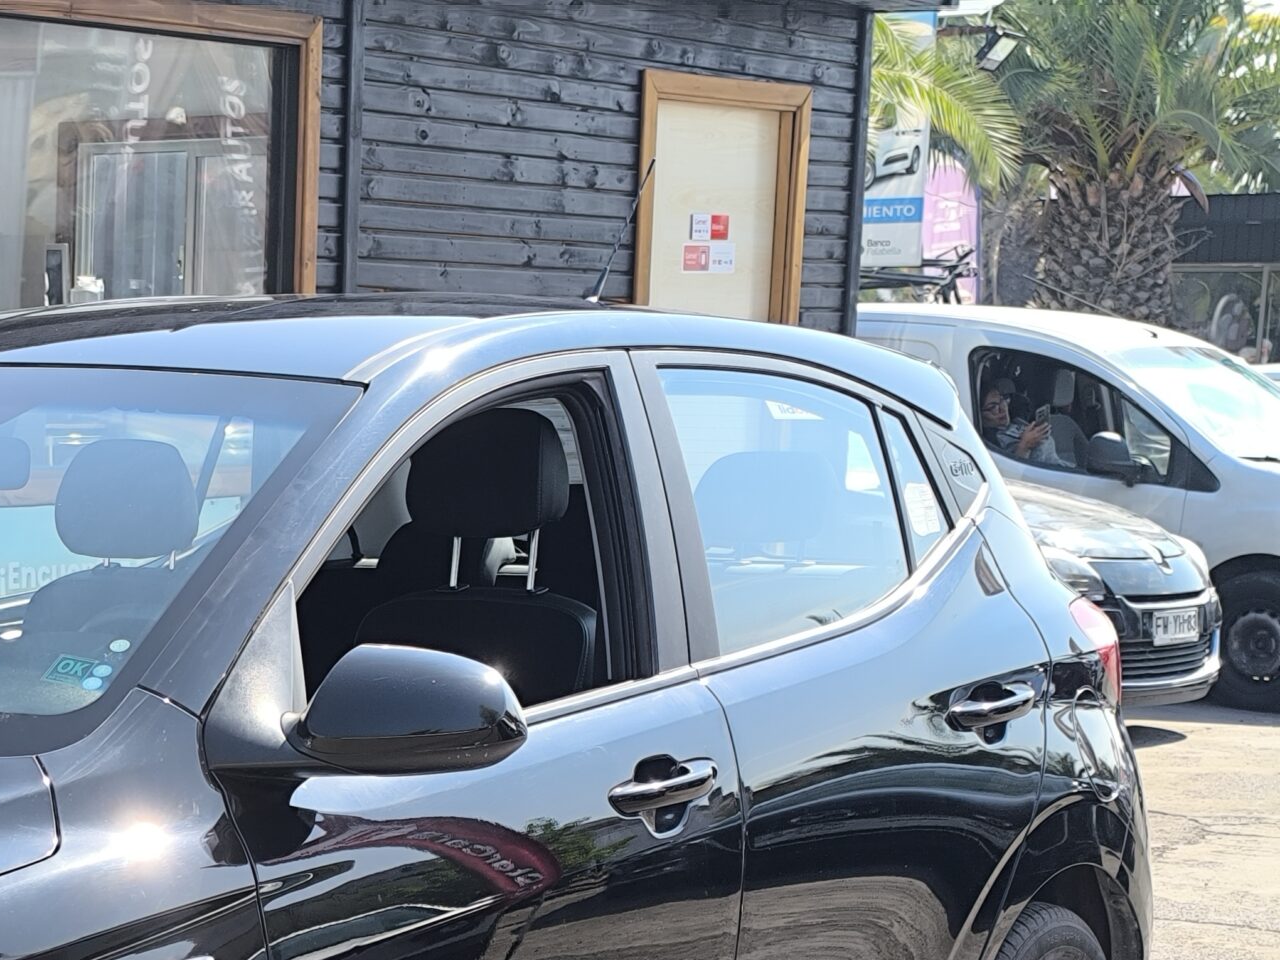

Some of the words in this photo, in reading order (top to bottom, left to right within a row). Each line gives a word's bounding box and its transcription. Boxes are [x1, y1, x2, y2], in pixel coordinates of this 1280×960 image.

[867, 239, 891, 248] Banco
[0, 561, 94, 595] ¡Encu
[57, 659, 90, 677] OK
